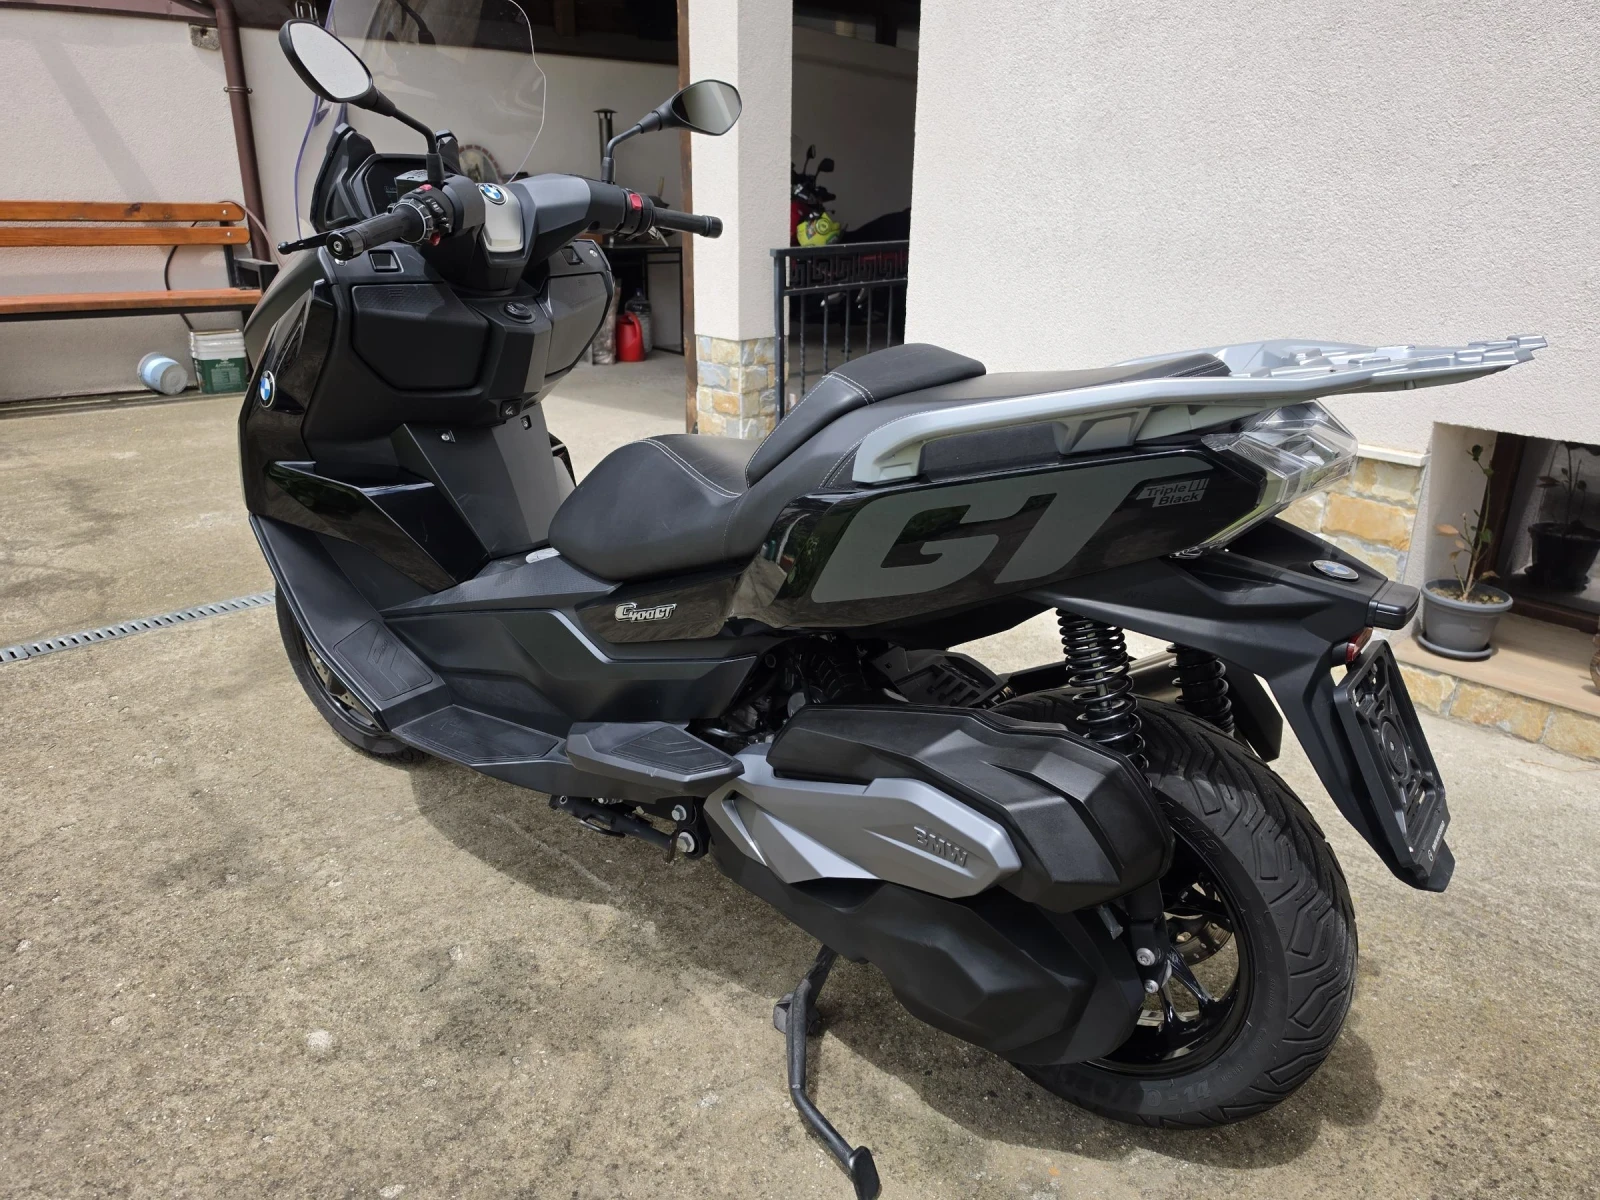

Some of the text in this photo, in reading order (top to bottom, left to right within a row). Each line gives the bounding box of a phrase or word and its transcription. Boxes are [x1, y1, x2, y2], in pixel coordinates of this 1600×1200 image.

[1147, 483, 1186, 497] Triple
[1158, 492, 1200, 505] Black
[811, 456, 1213, 603] GT
[913, 826, 968, 867] BMW
